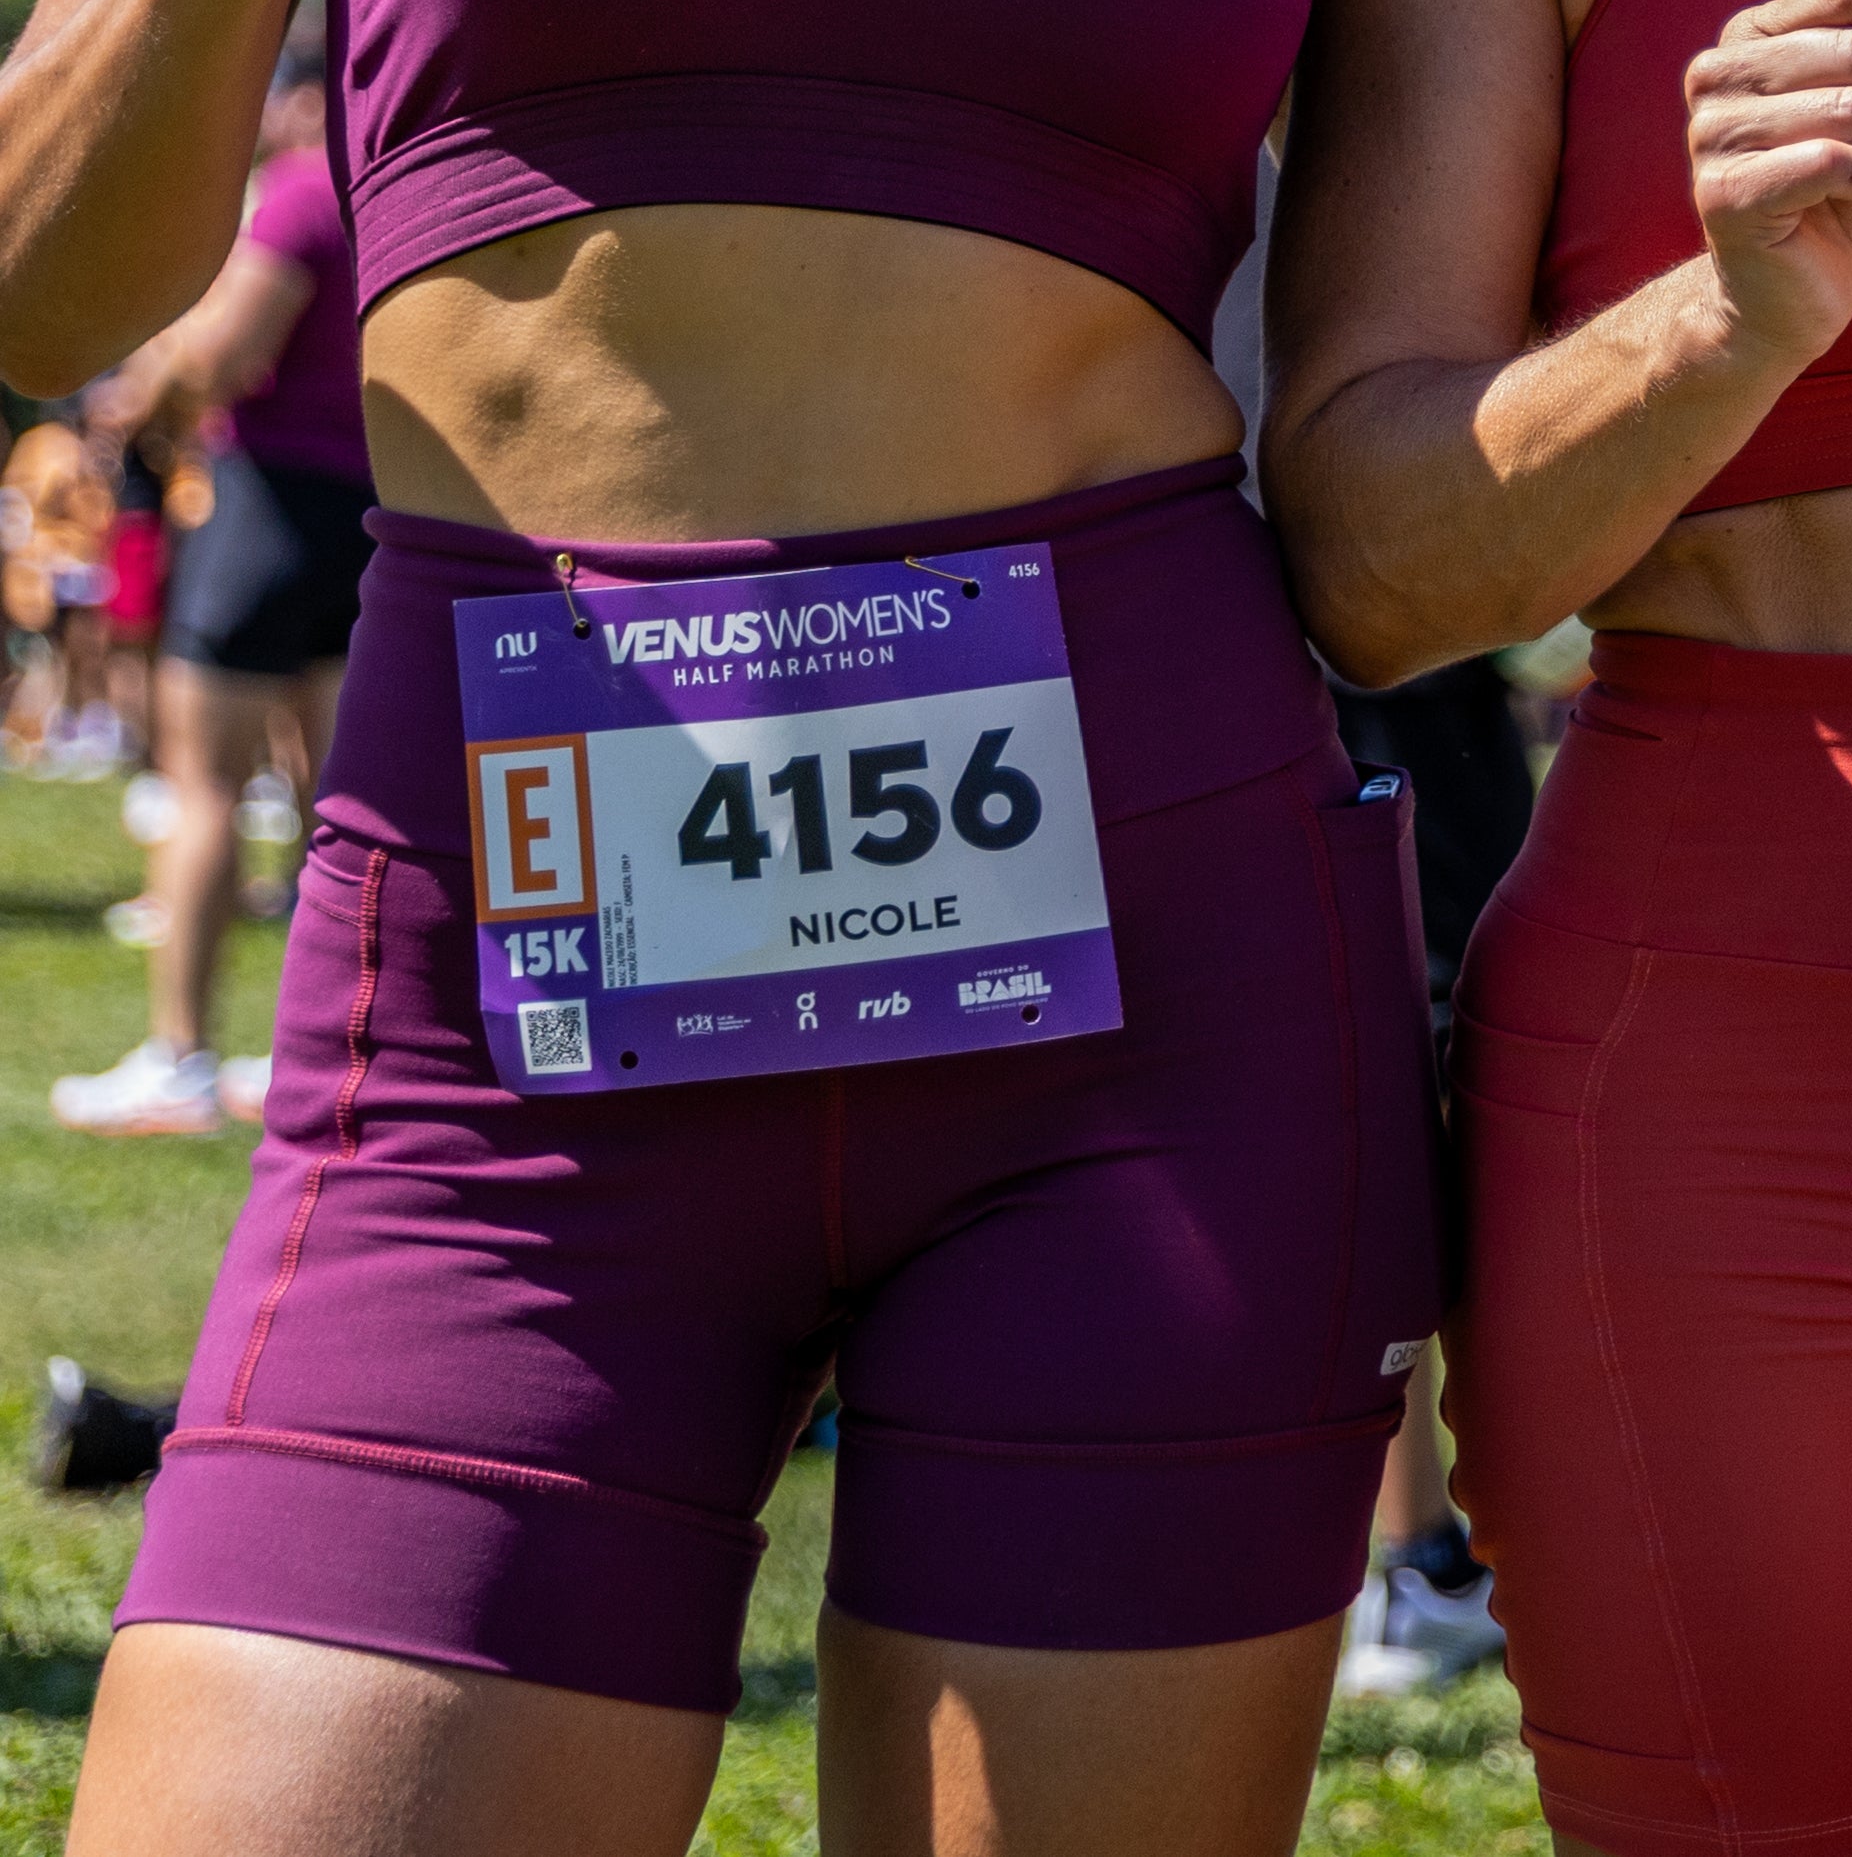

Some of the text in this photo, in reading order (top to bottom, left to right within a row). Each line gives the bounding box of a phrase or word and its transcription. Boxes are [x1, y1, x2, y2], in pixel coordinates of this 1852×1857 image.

[1009, 563, 1041, 579] 4156
[674, 645, 896, 687] HALF MARATHON
[677, 727, 1042, 881] 4156
[505, 766, 558, 894] E
[790, 895, 961, 948] NICOLE
[505, 928, 589, 978] 15K
[858, 992, 911, 1020] rvb
[958, 971, 1052, 1006] BRASIL
